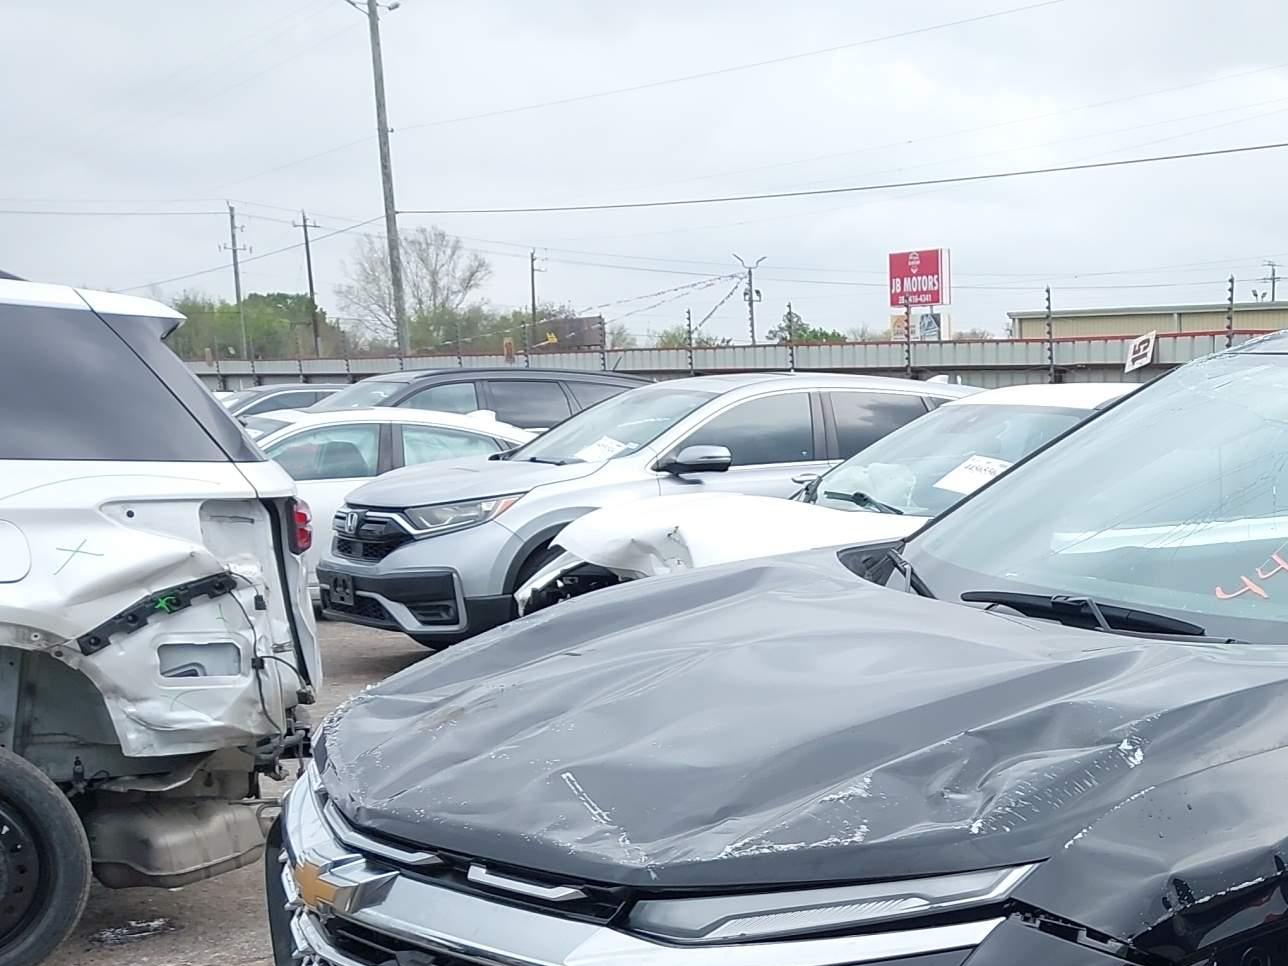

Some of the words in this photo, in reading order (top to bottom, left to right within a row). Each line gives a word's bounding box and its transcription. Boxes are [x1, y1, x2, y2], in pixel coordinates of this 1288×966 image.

[892, 278, 901, 294] JB
[904, 275, 938, 292] MOTORS
[1131, 337, 1151, 366] 15
